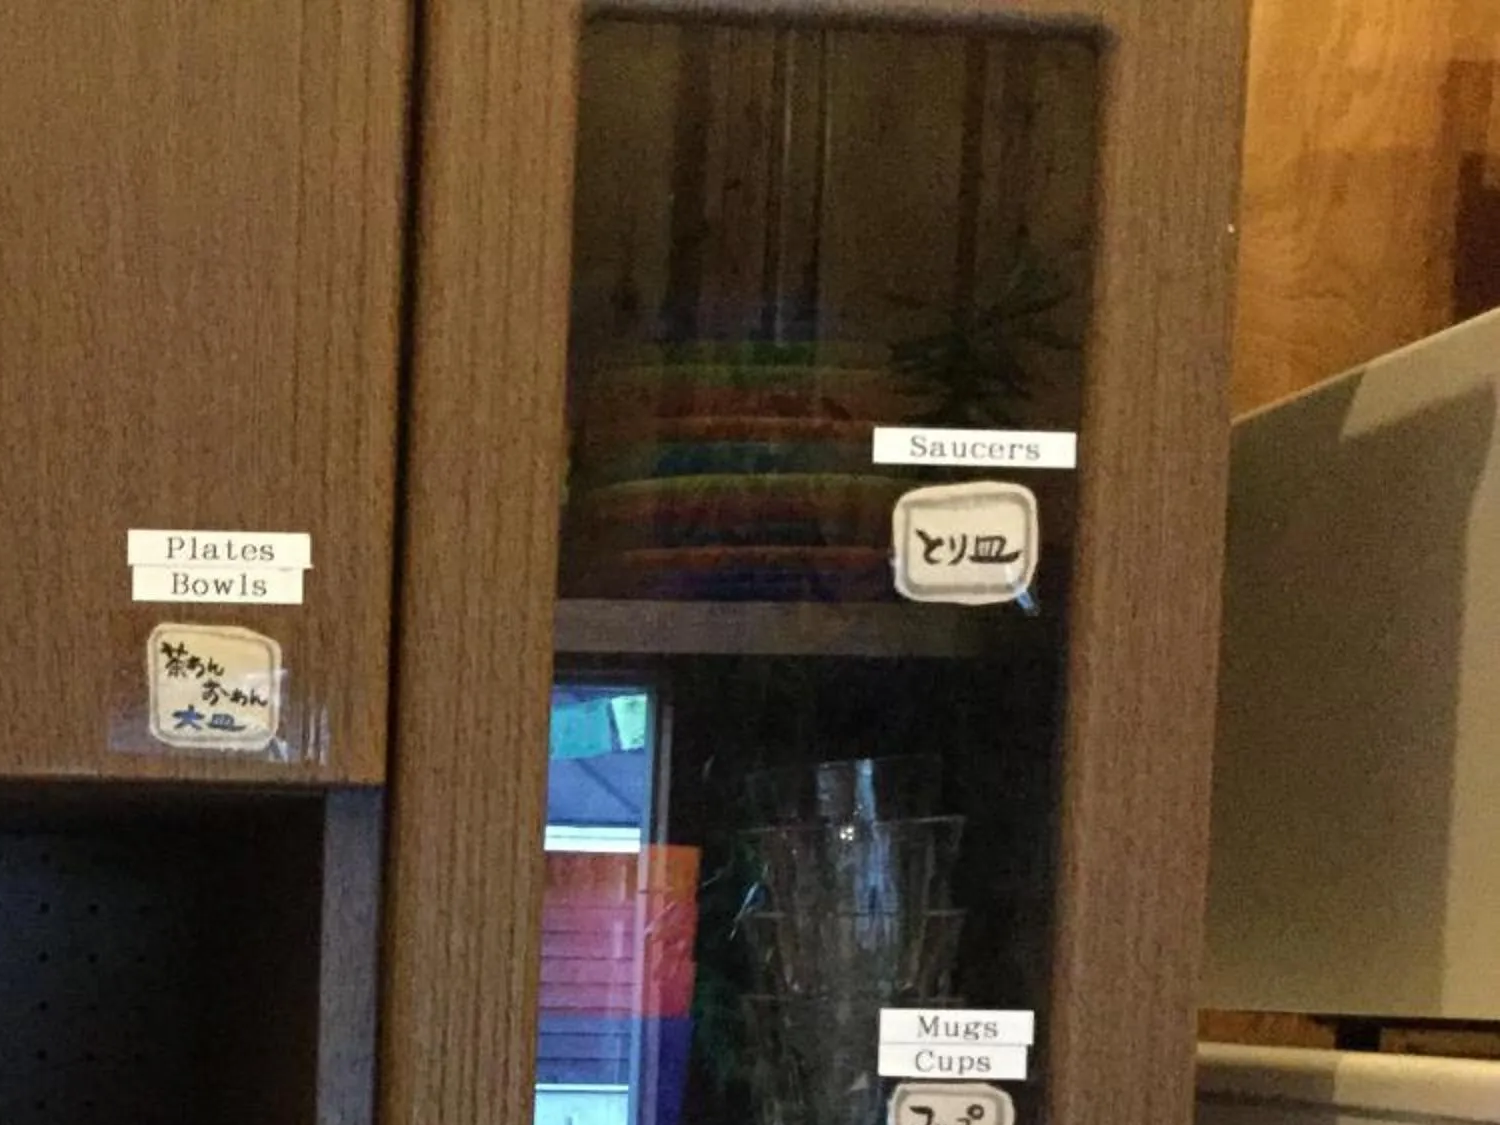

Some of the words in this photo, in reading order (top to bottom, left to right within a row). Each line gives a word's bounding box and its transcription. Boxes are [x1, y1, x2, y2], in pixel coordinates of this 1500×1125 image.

[909, 435, 1041, 460] Saucers
[165, 536, 275, 562] Plates
[916, 529, 1022, 566] とり皿
[171, 572, 267, 597] Bowls
[161, 641, 224, 678] 茶わん
[172, 704, 246, 731] 大皿
[916, 1015, 999, 1040] Mugs
[914, 1049, 992, 1075] Cups
